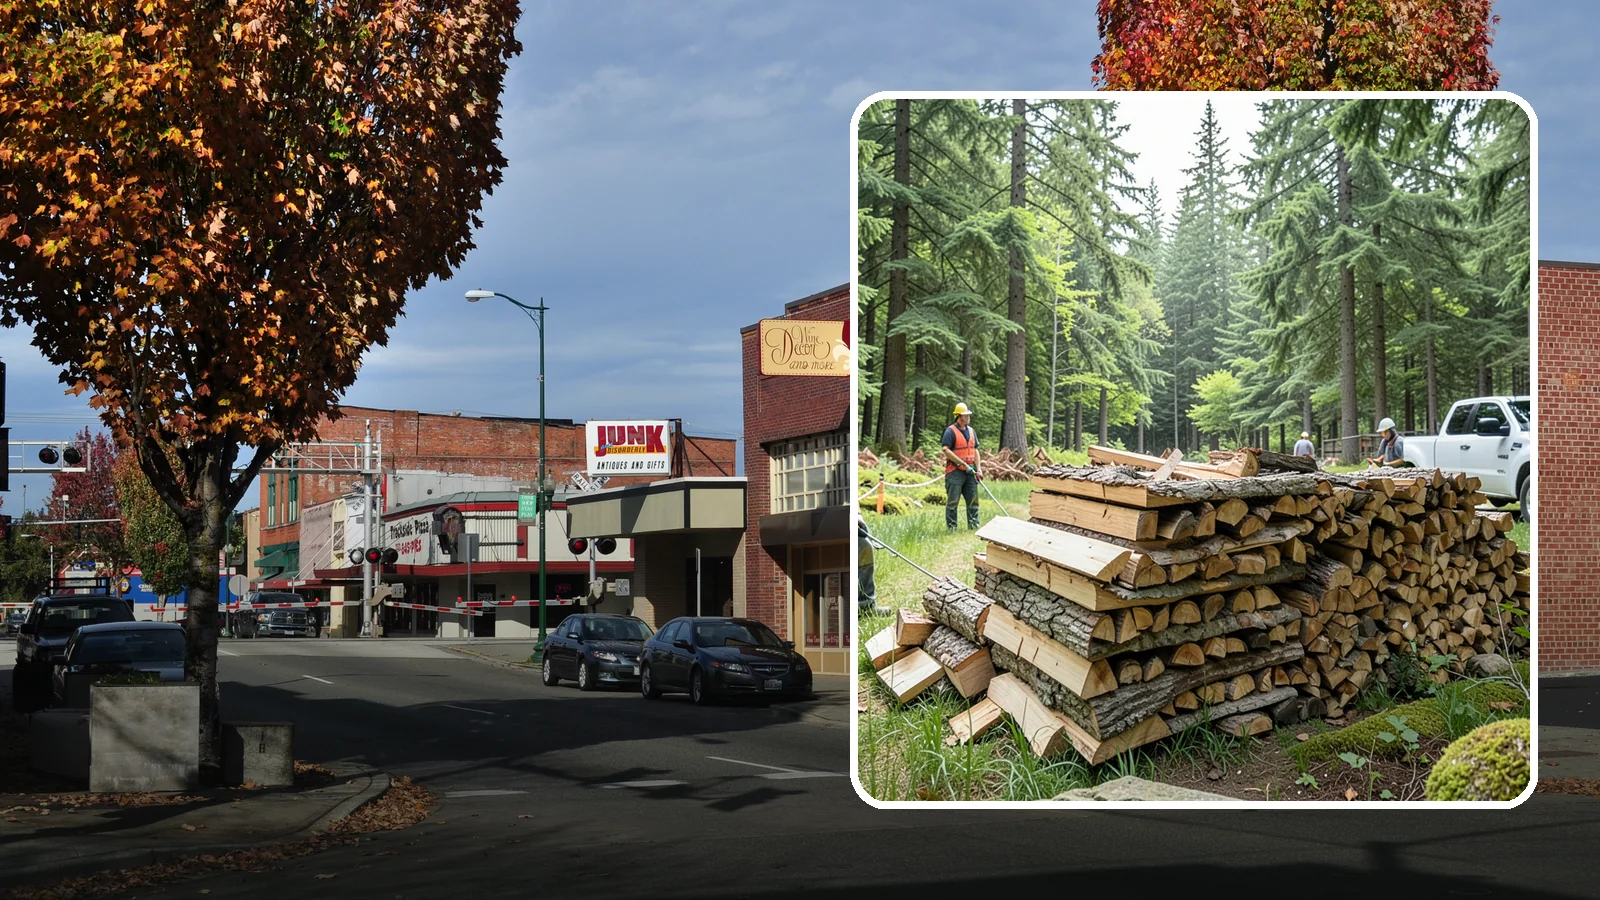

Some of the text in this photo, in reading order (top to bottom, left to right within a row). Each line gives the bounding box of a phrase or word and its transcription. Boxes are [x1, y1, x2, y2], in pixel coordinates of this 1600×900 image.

[595, 425, 665, 457] JUNK
[607, 446, 646, 454] DISORDERLY
[597, 460, 666, 470] ANTIQUES AND GIFTS
[590, 476, 609, 492] SING
[390, 519, 429, 539] Trackside Pizza
